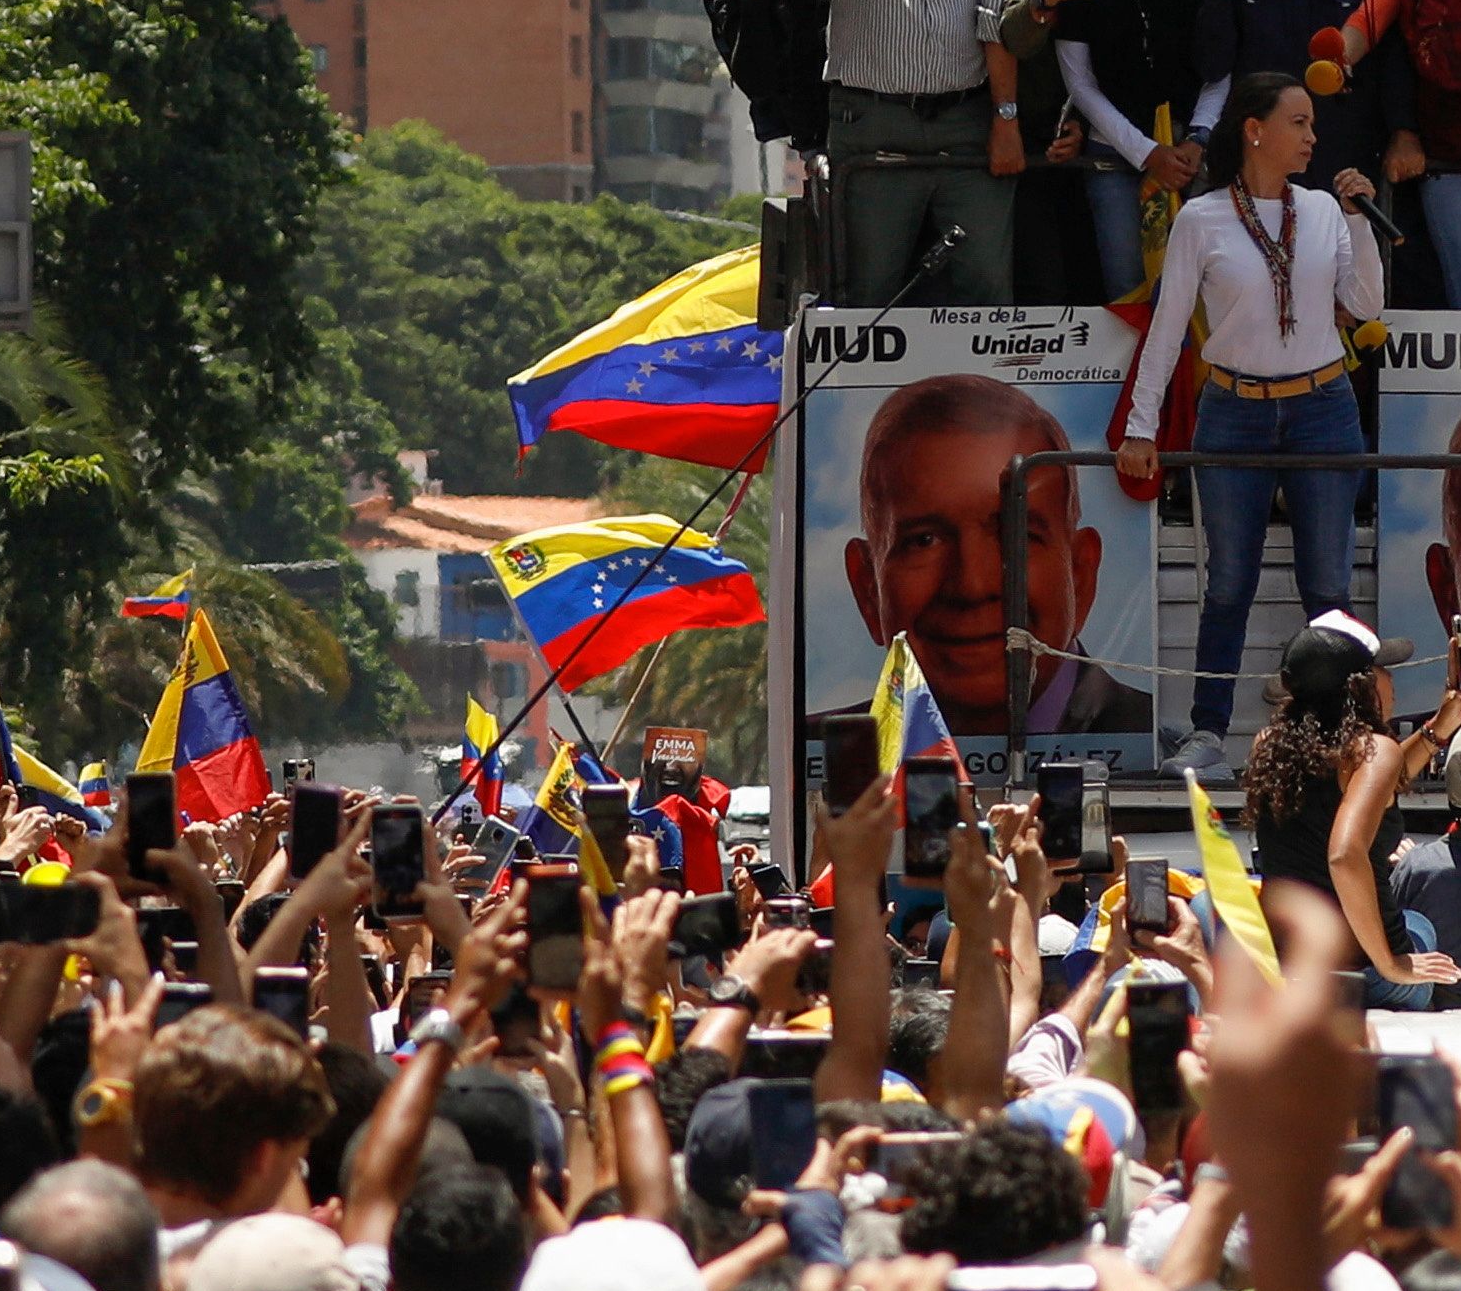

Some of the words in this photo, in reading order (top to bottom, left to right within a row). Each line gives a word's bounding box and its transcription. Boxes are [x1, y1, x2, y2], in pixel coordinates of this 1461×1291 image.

[930, 307, 981, 324] Mesa
[805, 325, 908, 363] MUD
[971, 333, 1066, 356] Unidad
[1016, 366, 1122, 382] Democrática
[655, 739, 696, 751] EMMA
[966, 744, 1124, 774] GOZÁEZ
